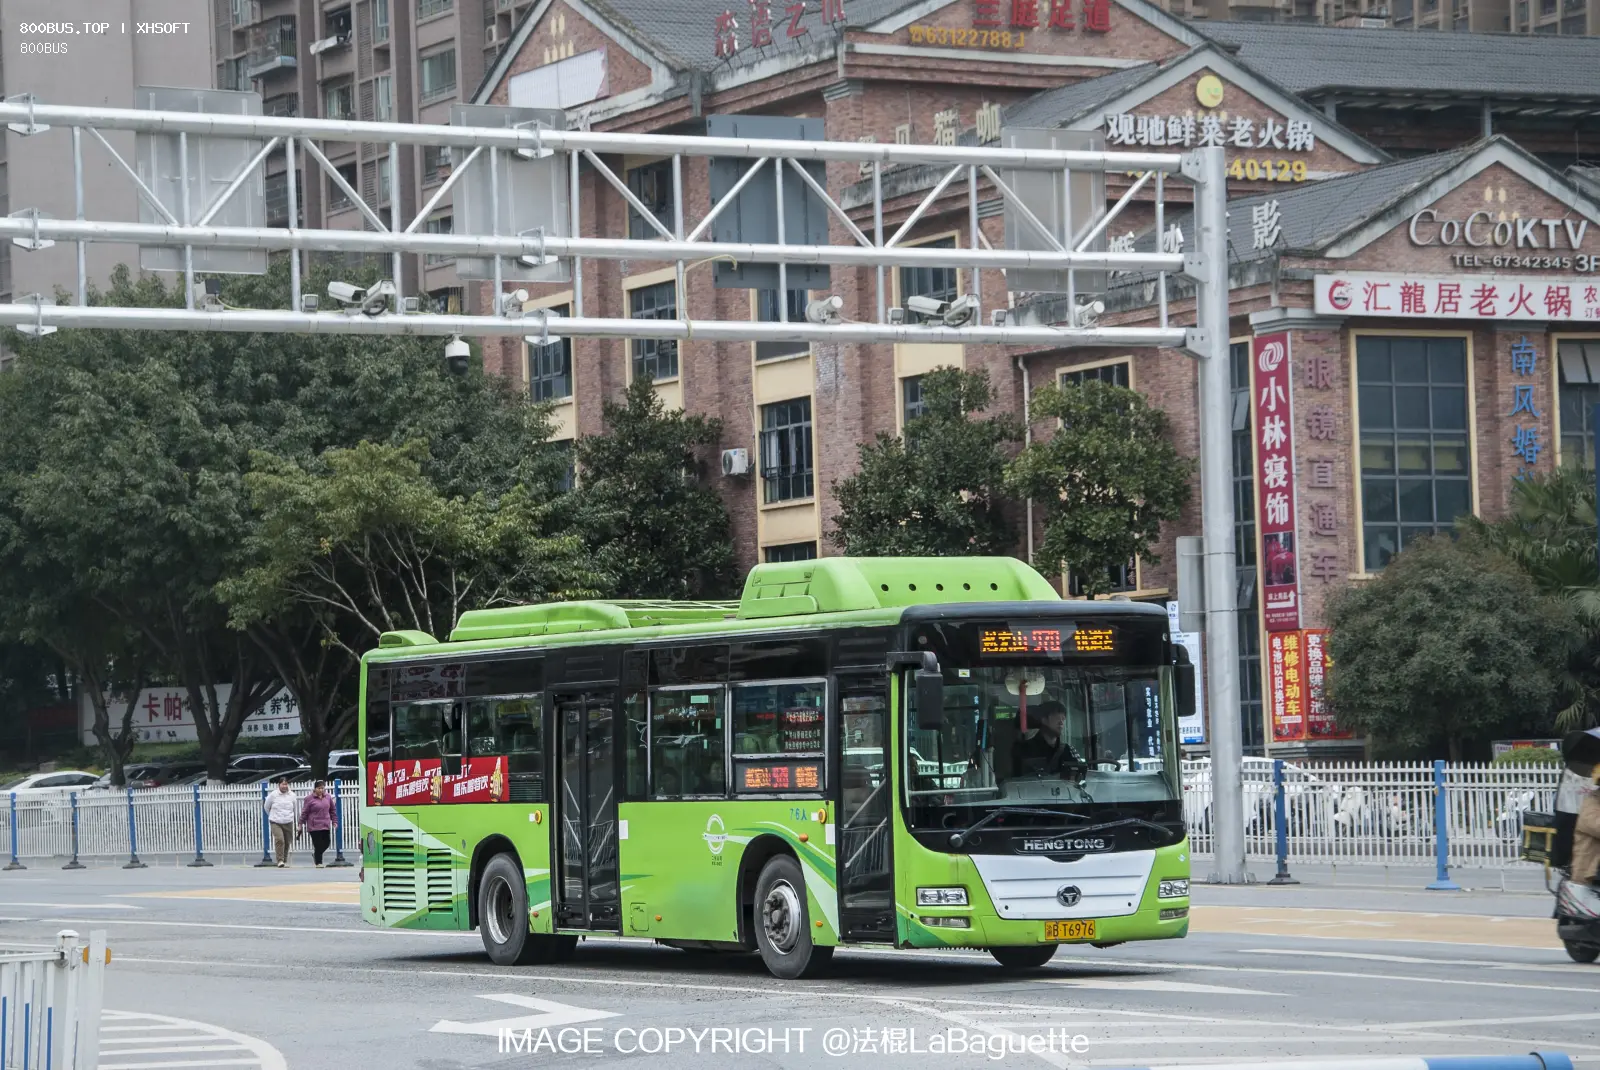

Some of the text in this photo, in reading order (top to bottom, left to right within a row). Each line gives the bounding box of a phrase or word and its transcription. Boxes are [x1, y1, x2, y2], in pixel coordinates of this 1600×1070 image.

[1224, 157, 1308, 182] 40129
[1259, 376, 1290, 526] 小林寝饰
[1303, 333, 1338, 584] 眼镜直通车
[1272, 636, 1285, 716] 电池以旧换新
[1283, 634, 1301, 715] 维修电动车
[1307, 633, 1325, 714] 更换品牌电池
[1023, 838, 1105, 851] HENGTONG
